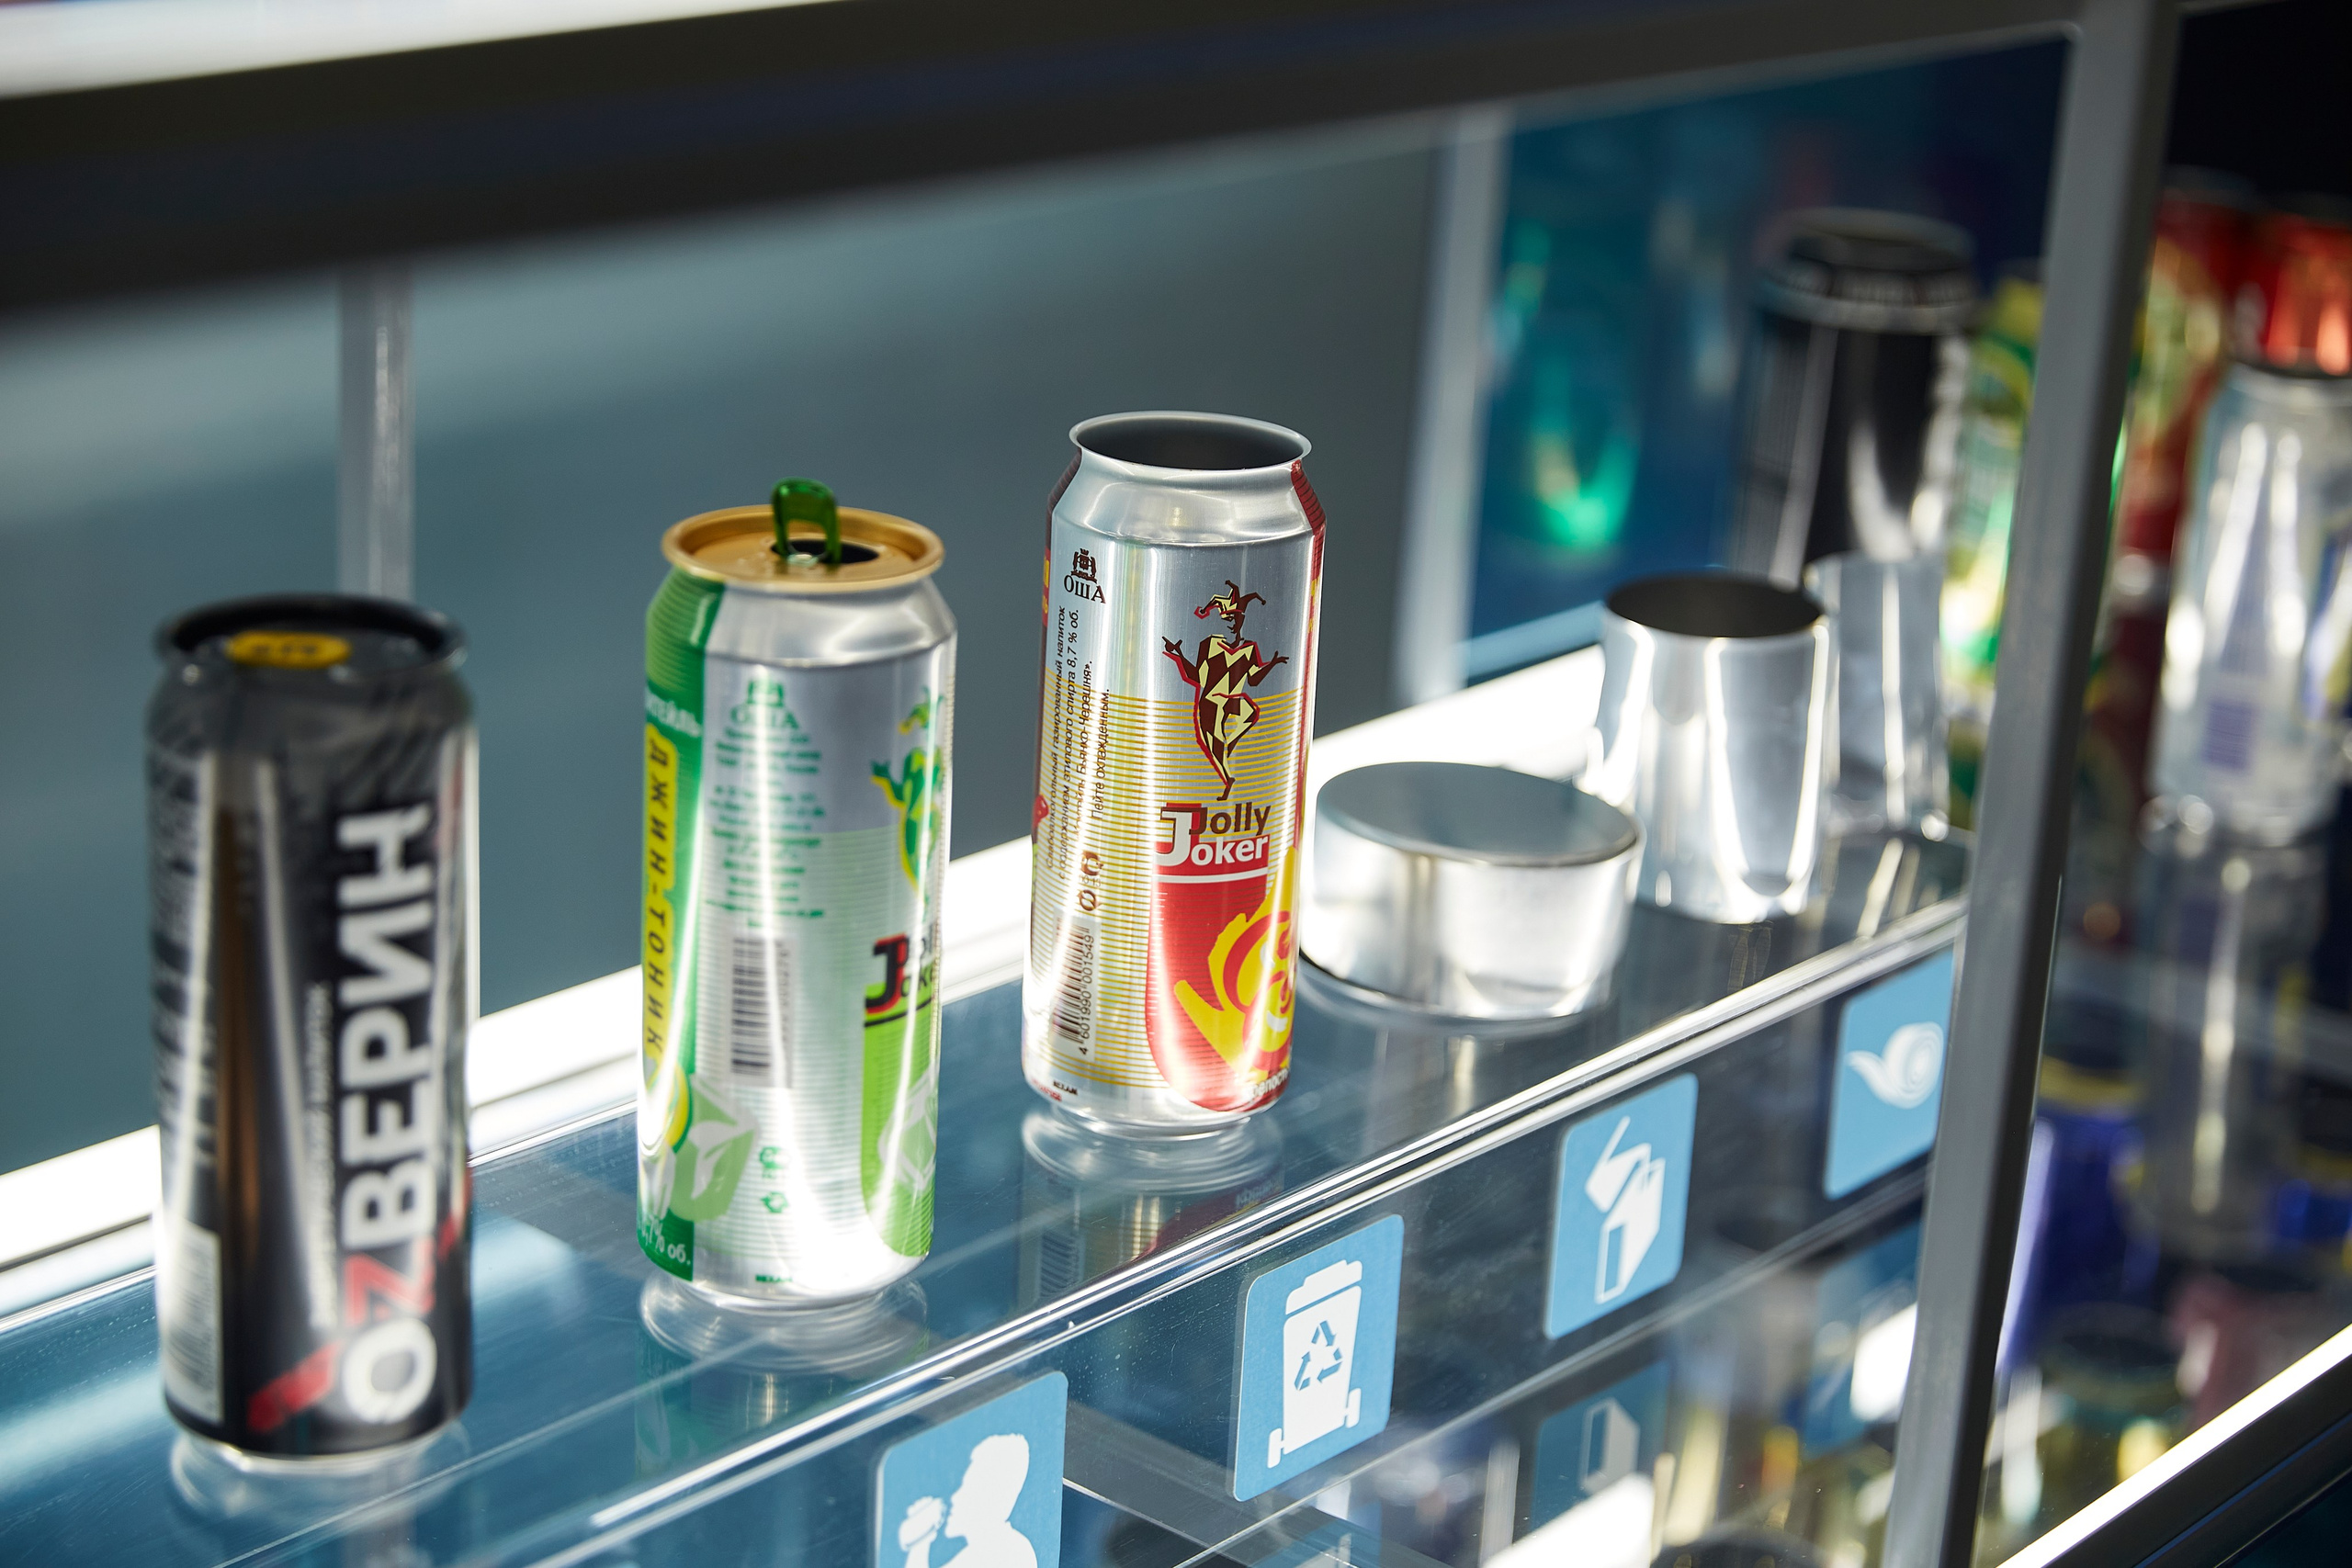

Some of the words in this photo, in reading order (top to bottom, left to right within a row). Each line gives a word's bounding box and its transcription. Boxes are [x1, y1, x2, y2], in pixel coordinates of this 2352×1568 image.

[1057, 605, 1066, 658] напиток
[1068, 632, 1078, 643] %
[1069, 609, 1079, 628] об.
[1067, 646, 1078, 668] 8,7
[1052, 660, 1063, 750] газированный
[1067, 671, 1077, 715] спирта
[1063, 718, 1073, 782] этилового
[1096, 689, 1110, 779] охлажденным.
[1046, 751, 1058, 868] Слабоалкогольный
[1091, 782, 1105, 820] Пейте
[1160, 802, 1271, 836] Jolly
[1059, 784, 1070, 869] содержанием
[1155, 811, 1268, 866] Joker
[1081, 934, 1094, 984] 001549
[1080, 990, 1091, 1039] 601990
[1079, 1046, 1089, 1055] 4
